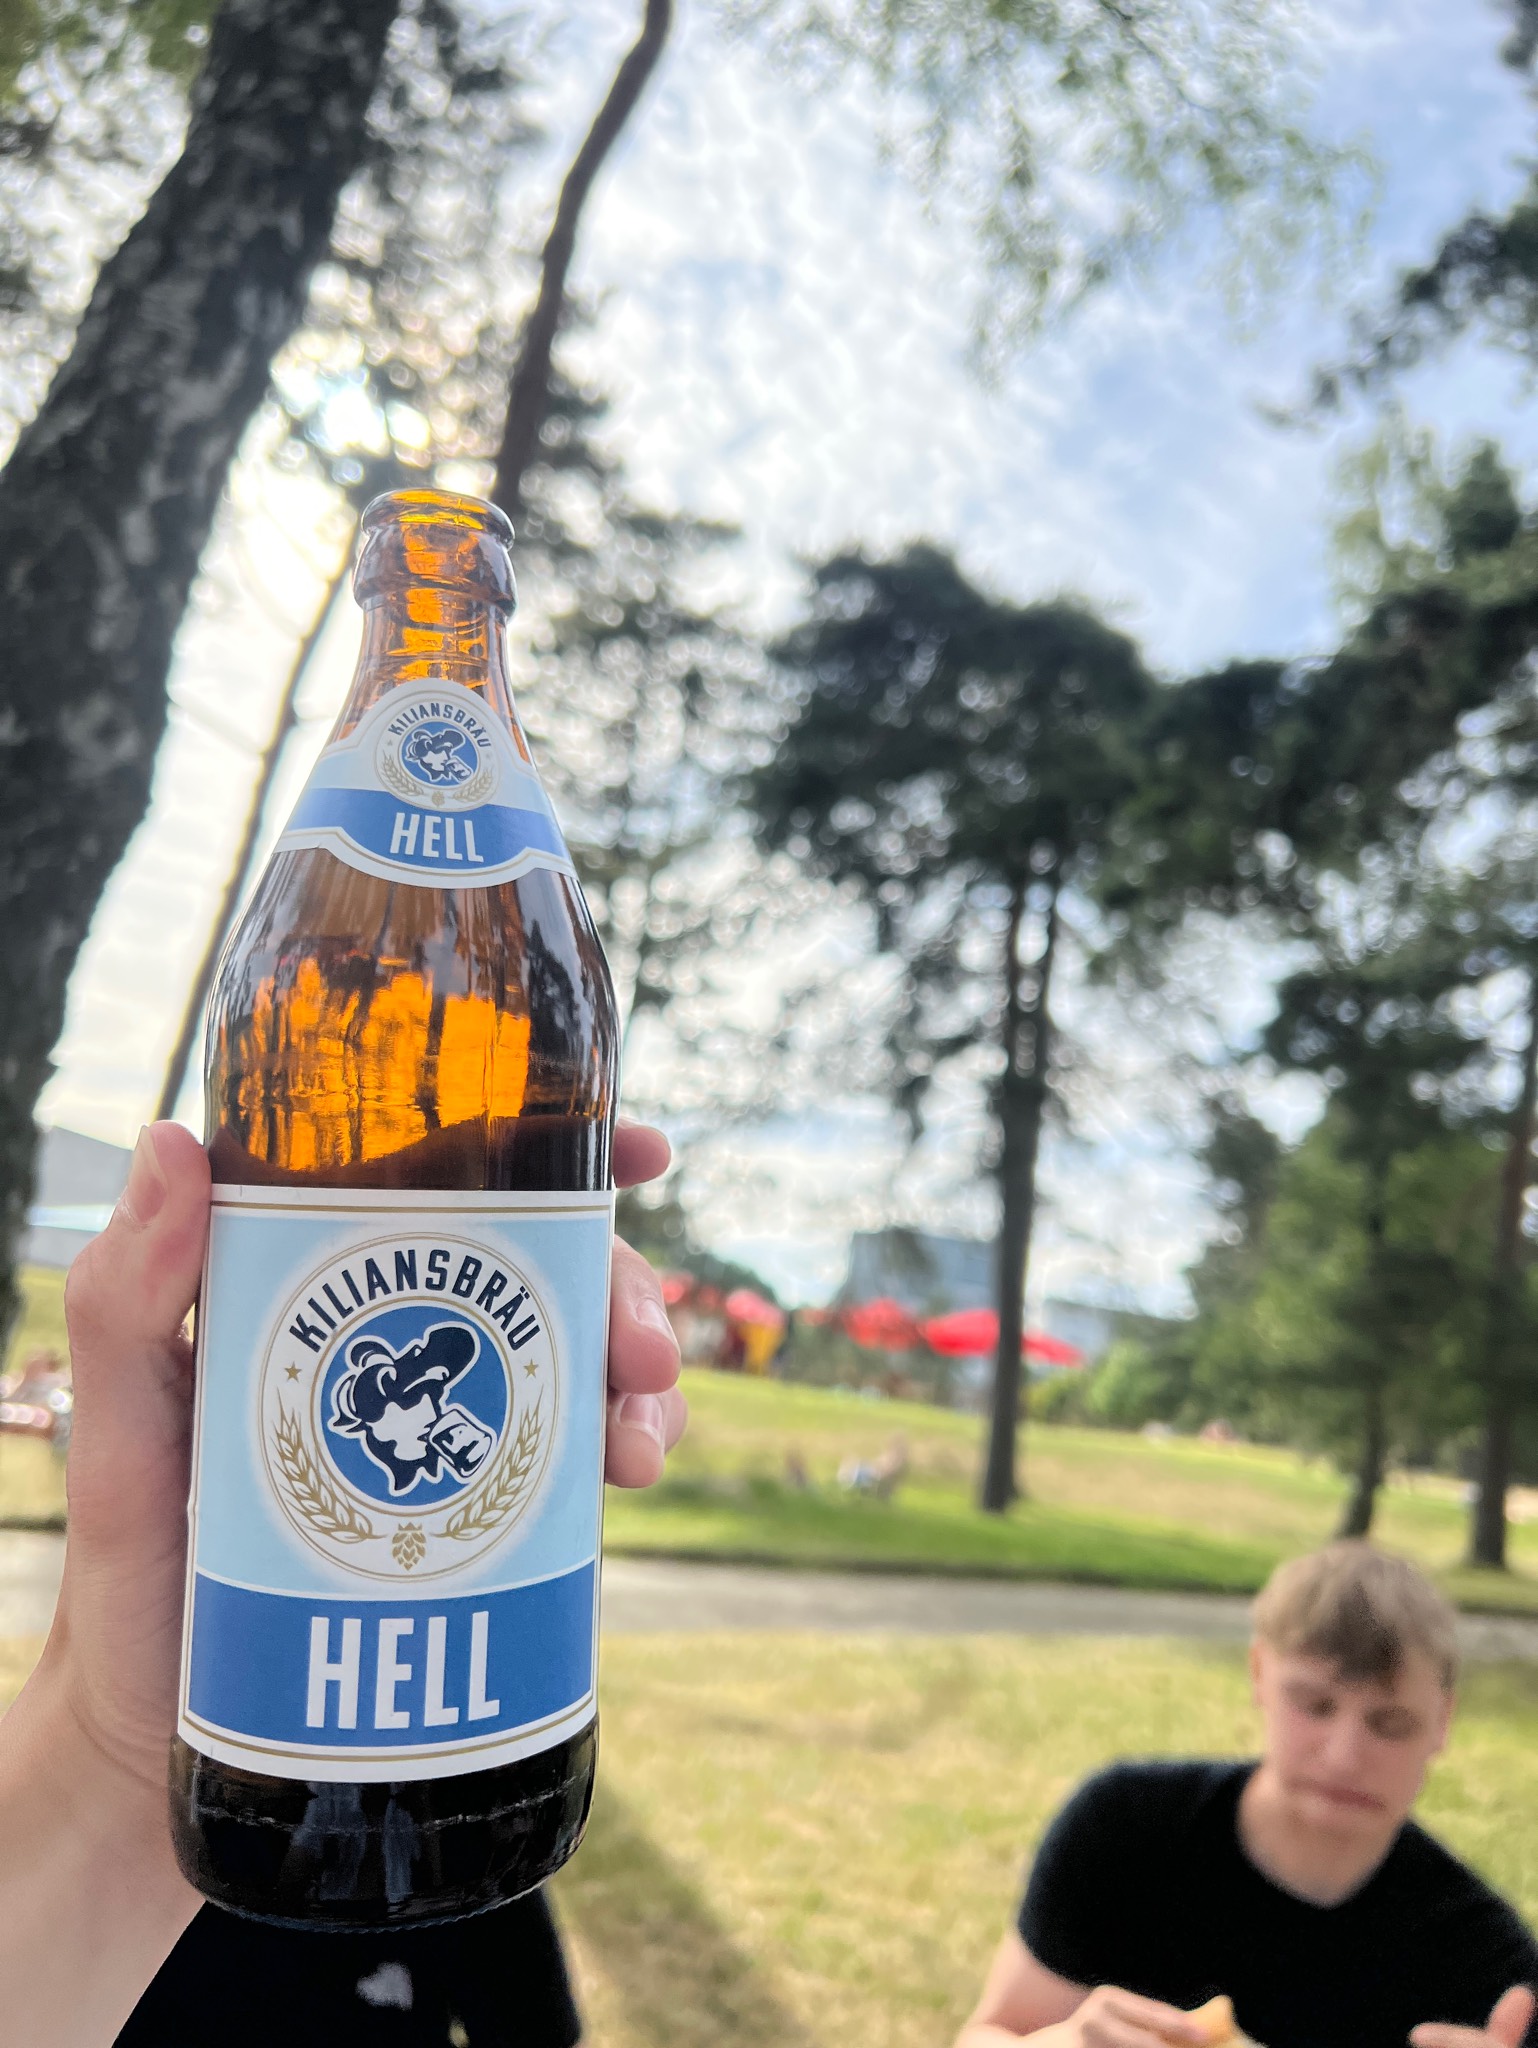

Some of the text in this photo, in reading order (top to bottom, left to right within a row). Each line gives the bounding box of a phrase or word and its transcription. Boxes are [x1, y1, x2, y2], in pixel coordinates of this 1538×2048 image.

[388, 703, 491, 748] KILIANSBRÄU
[390, 812, 484, 863] HELL
[289, 1249, 544, 1353] KILIANSBRÄU
[306, 1610, 500, 1729] HELL
